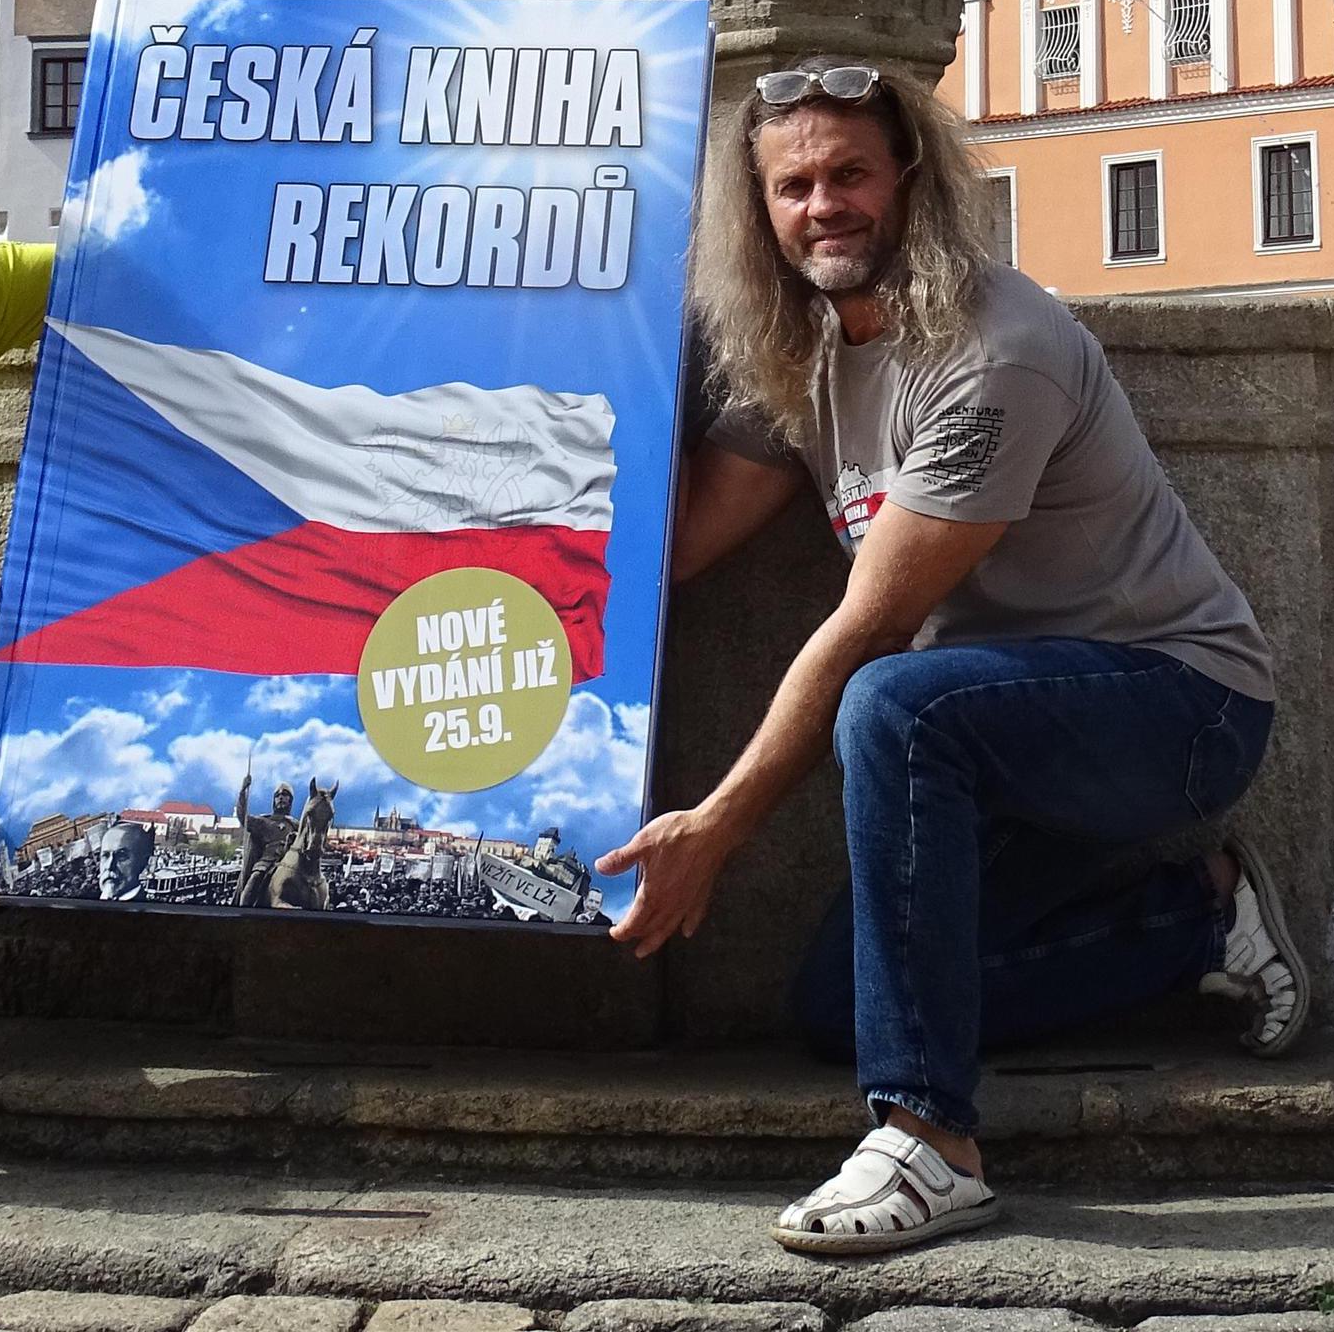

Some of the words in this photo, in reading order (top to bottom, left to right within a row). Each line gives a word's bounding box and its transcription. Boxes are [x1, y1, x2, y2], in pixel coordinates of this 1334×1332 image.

[130, 25, 379, 143] ČESKÁ
[399, 46, 643, 148] KNIHA
[263, 165, 637, 290] REKORDŮ
[417, 598, 507, 655] NOVÉ
[371, 646, 504, 710] VYDÁNÍ
[511, 639, 558, 691] JIŽ
[423, 704, 512, 753] 25.9.
[481, 861, 516, 885] NEŽÍT
[517, 878, 534, 896] VE
[533, 886, 557, 907] LŽI
